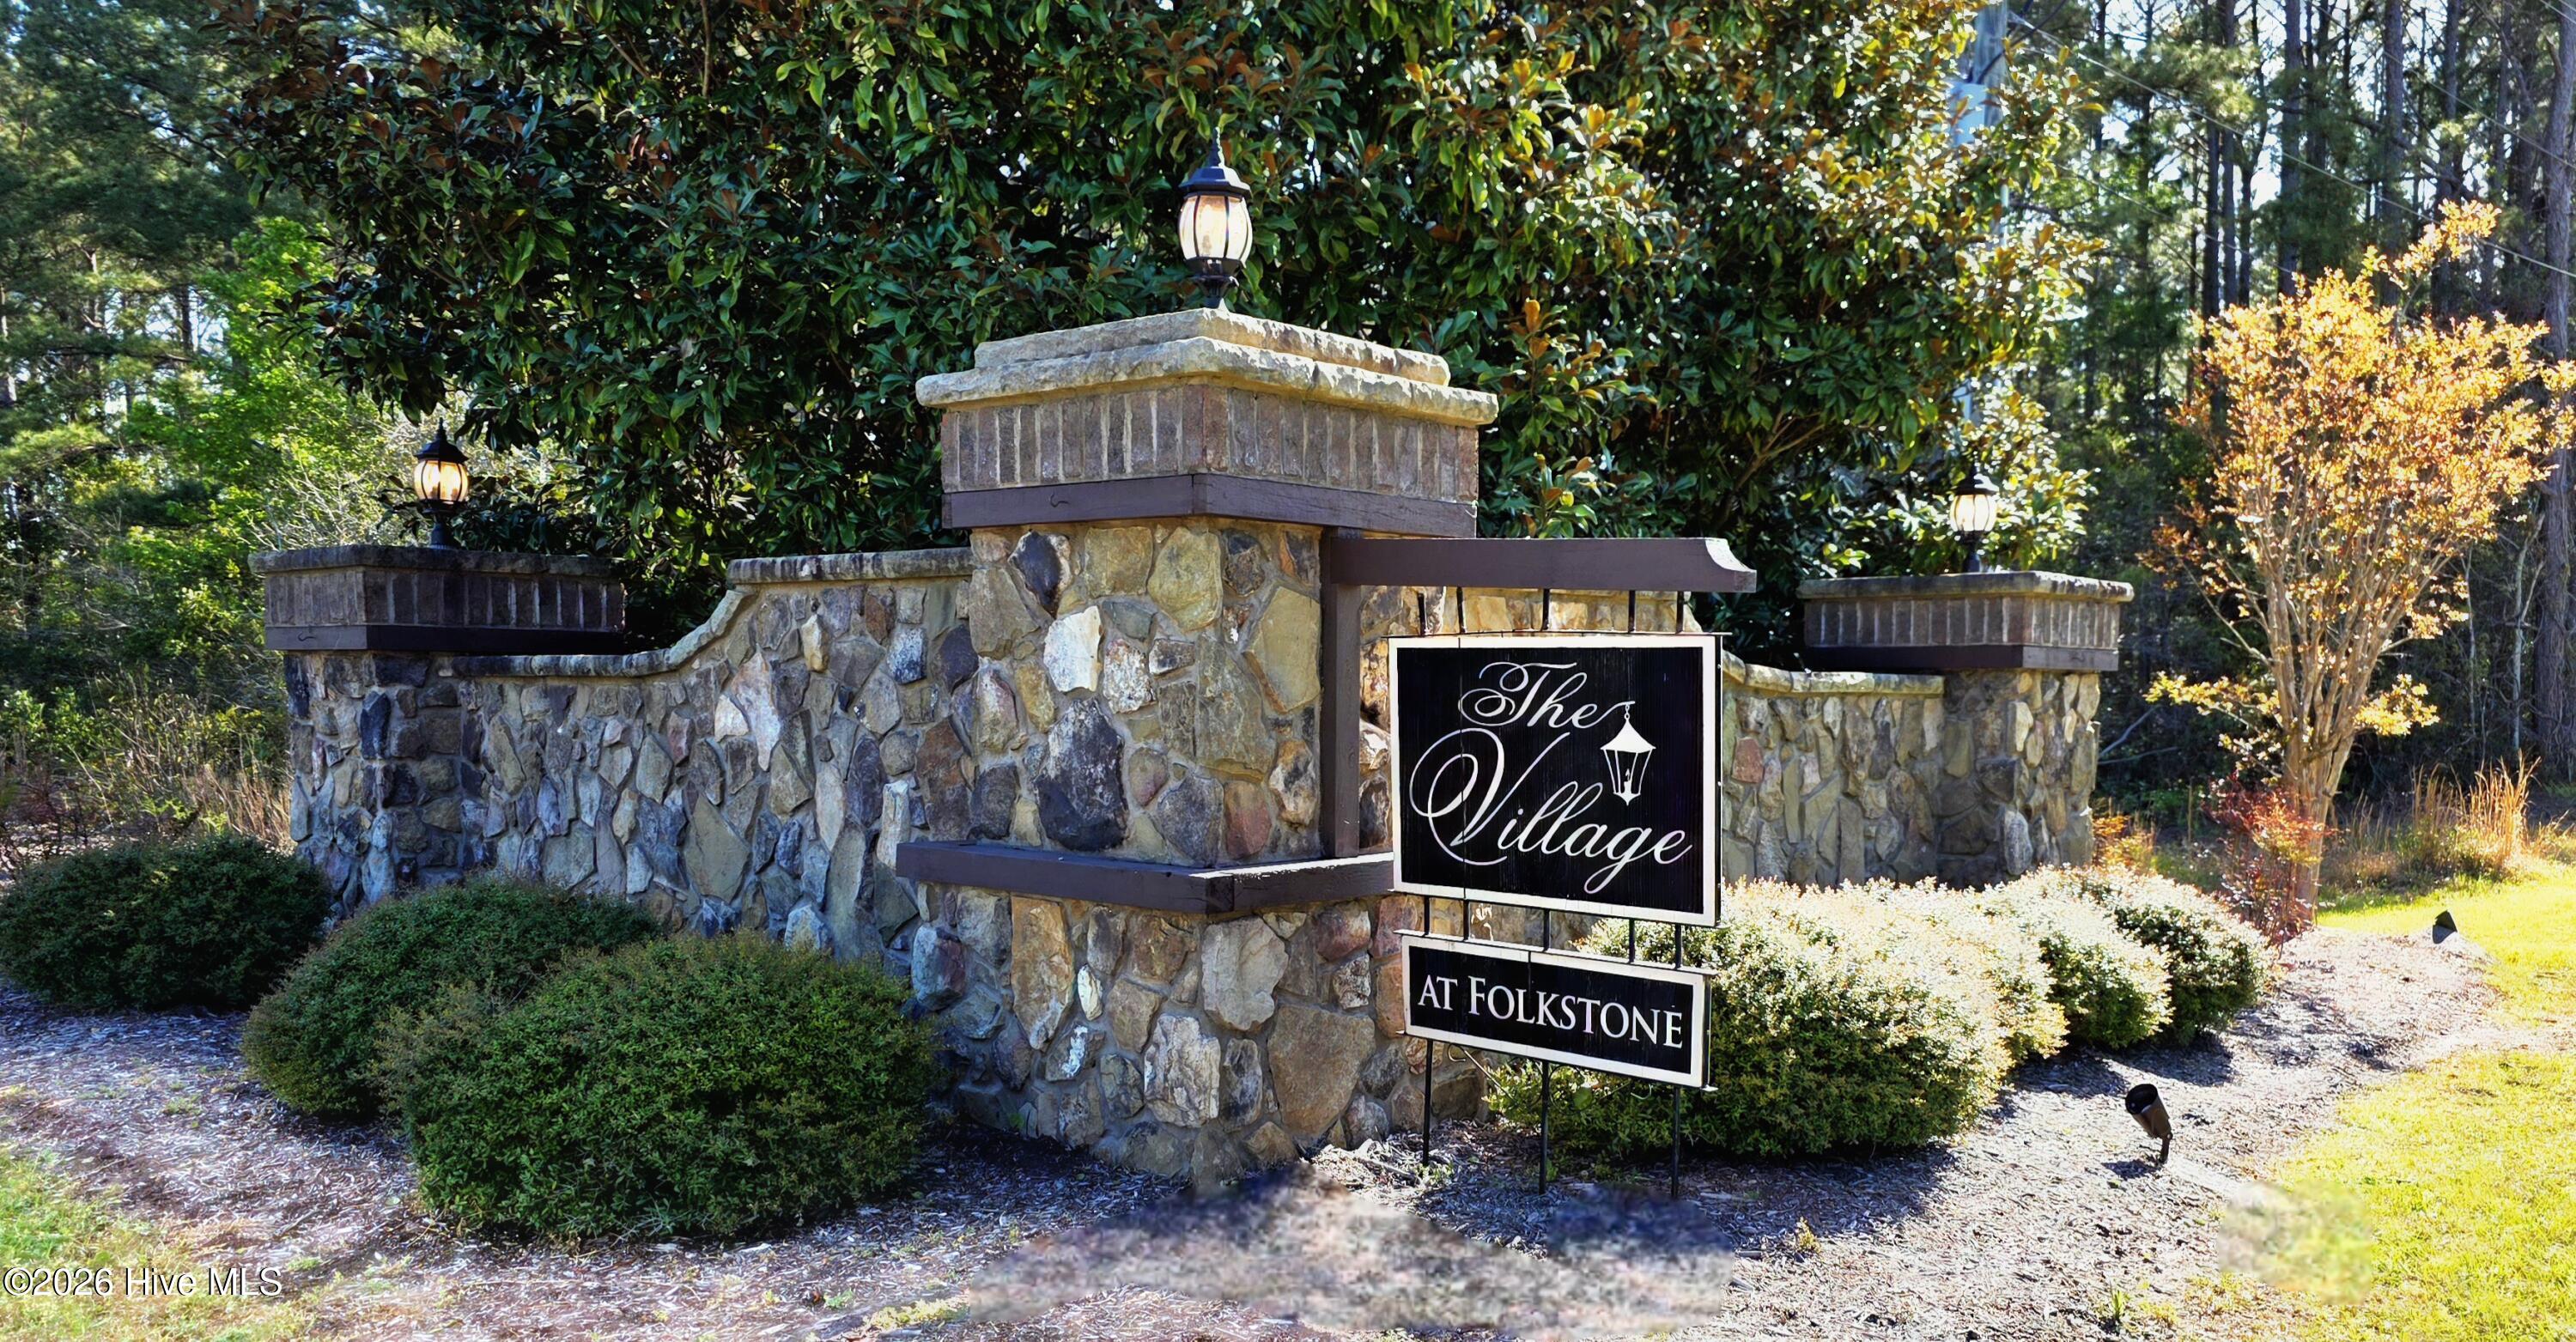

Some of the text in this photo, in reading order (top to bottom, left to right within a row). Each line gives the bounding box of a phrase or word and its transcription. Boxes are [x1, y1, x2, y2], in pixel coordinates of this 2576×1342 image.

[1458, 661, 1619, 730] The
[1409, 727, 1693, 895] Village
[1418, 975, 1684, 1049] AT FOLKSTONE
